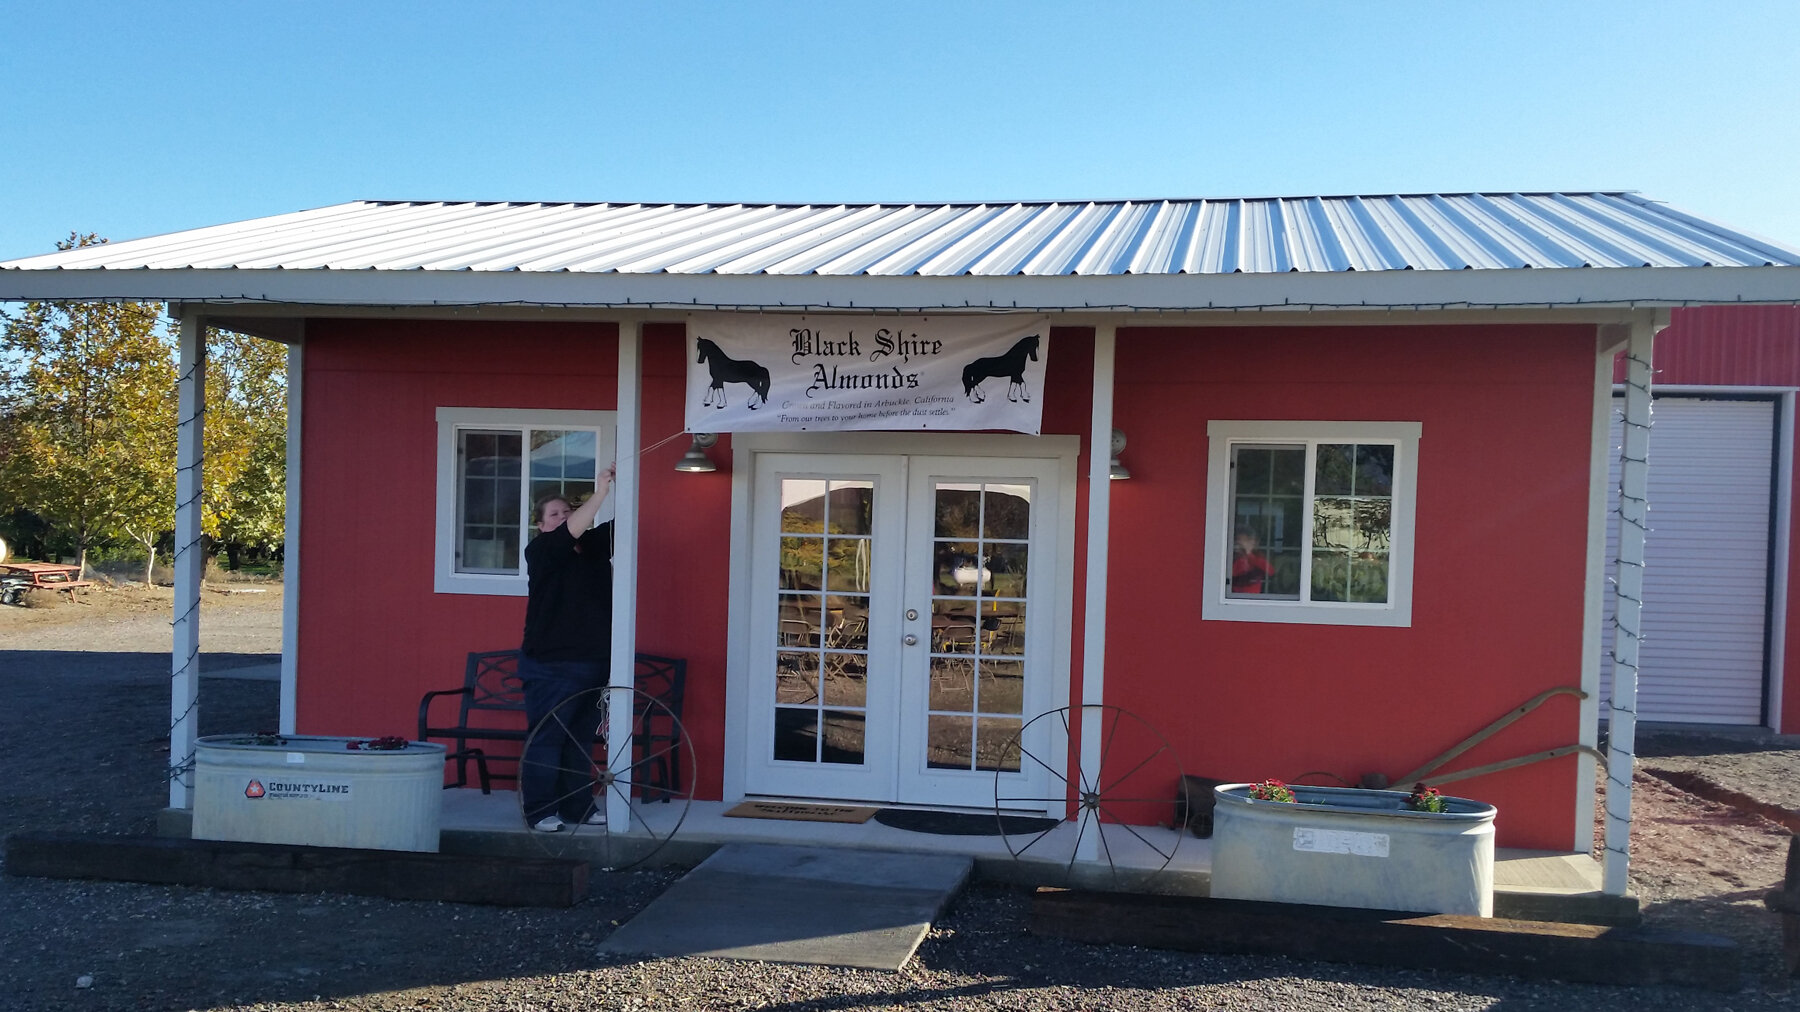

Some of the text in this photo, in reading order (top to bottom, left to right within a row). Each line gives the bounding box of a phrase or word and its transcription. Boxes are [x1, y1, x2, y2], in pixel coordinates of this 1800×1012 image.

[790, 328, 942, 365] Black Shire
[806, 363, 919, 398] Almonds
[828, 401, 862, 410] Flavored
[863, 401, 873, 409] in
[914, 395, 954, 405] California
[840, 415, 857, 424] your
[858, 412, 877, 420] home
[879, 409, 899, 419] before
[900, 408, 911, 416] the
[912, 408, 927, 416] dust
